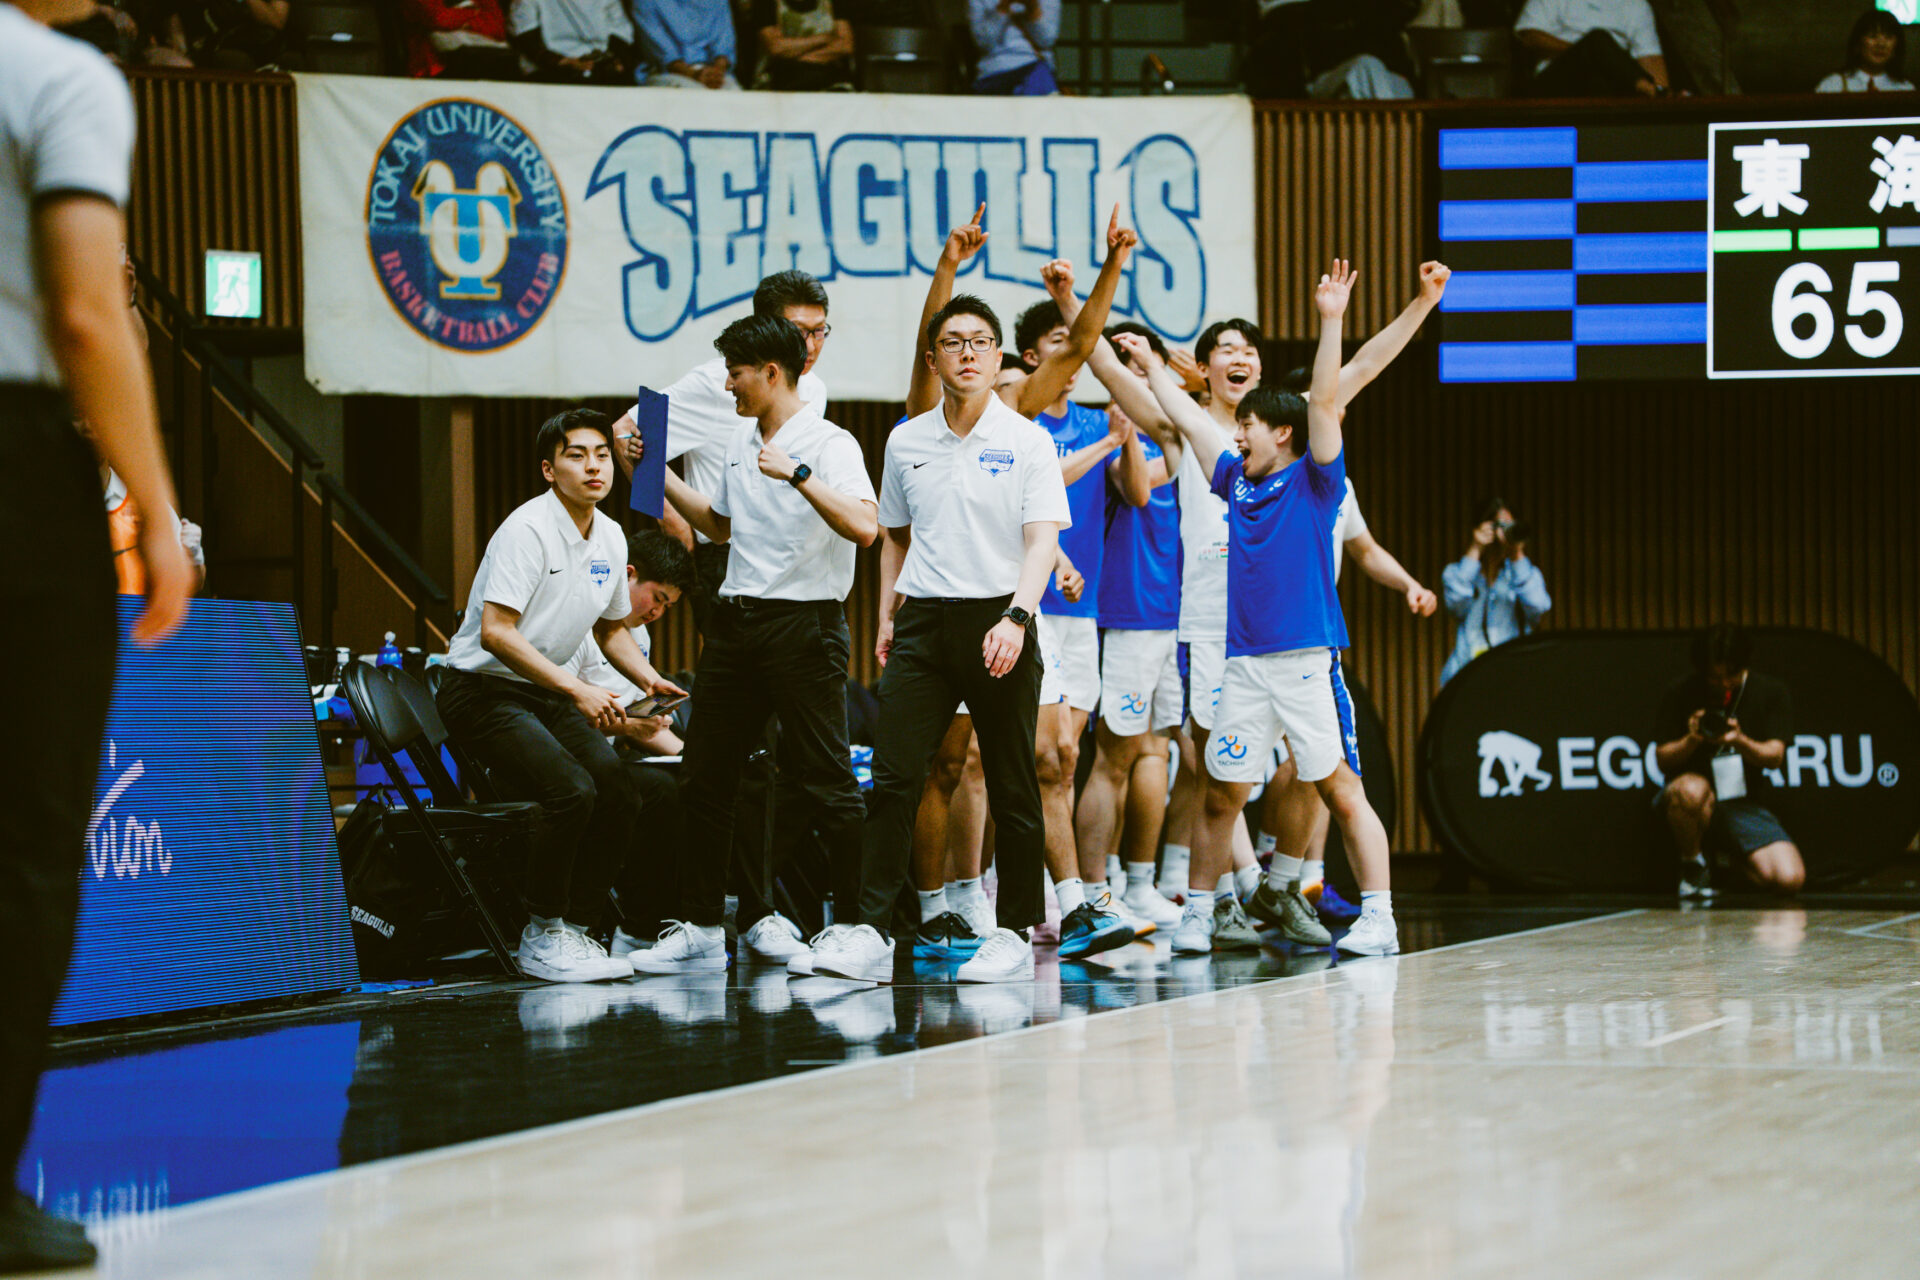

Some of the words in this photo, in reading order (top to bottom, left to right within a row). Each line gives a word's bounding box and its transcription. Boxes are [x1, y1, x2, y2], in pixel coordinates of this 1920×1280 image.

[371, 124, 427, 226] TOKAI
[426, 104, 566, 233] UNIVERSITY
[585, 125, 1206, 342] SEAGULLS
[380, 249, 518, 343] BASKETBALL
[516, 252, 560, 319] CLUB
[1772, 261, 1904, 359] 65
[1558, 734, 1874, 790] EGRU
[351, 905, 395, 939] SEAGULLS
